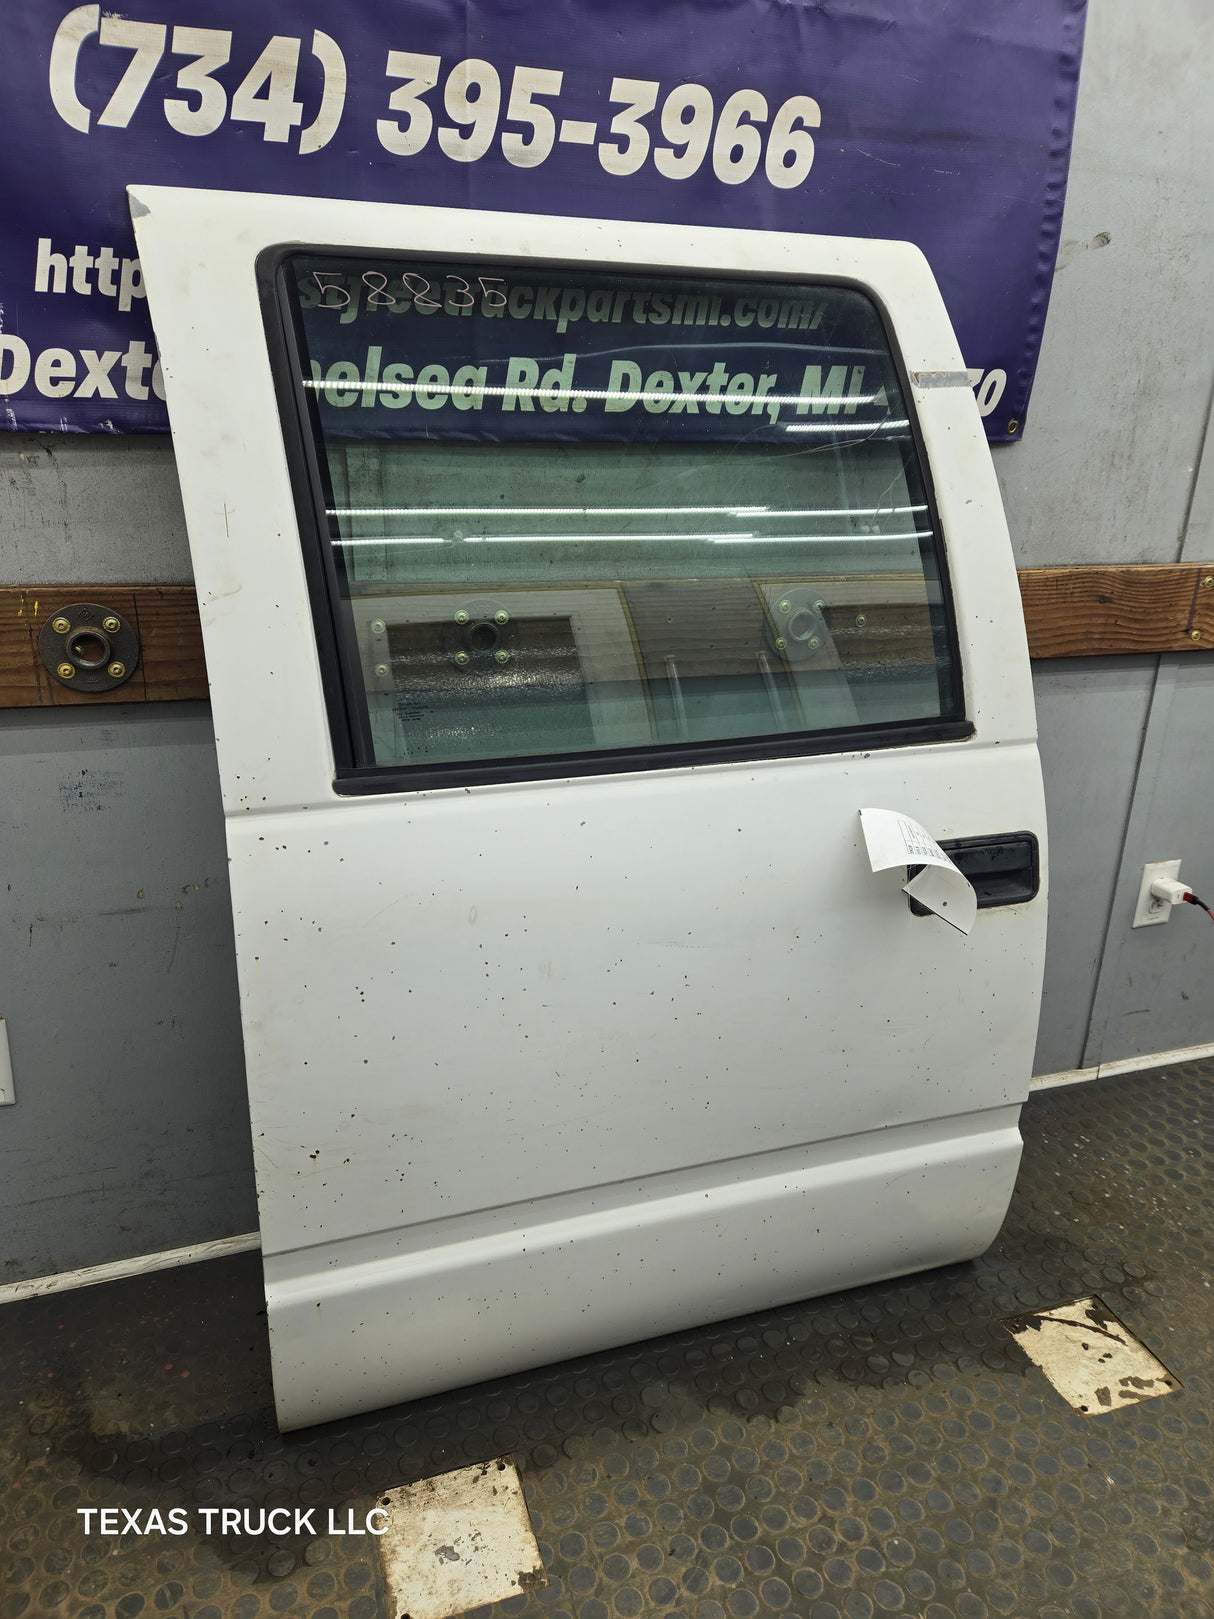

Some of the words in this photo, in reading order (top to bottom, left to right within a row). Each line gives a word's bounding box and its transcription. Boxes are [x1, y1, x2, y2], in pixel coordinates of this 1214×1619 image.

[49, 4, 347, 154] (734)
[376, 50, 822, 189] 395-3966
[313, 270, 508, 308] 58835
[501, 353, 587, 413] Rd.
[604, 359, 781, 425] Dexter,
[796, 365, 866, 415] MI
